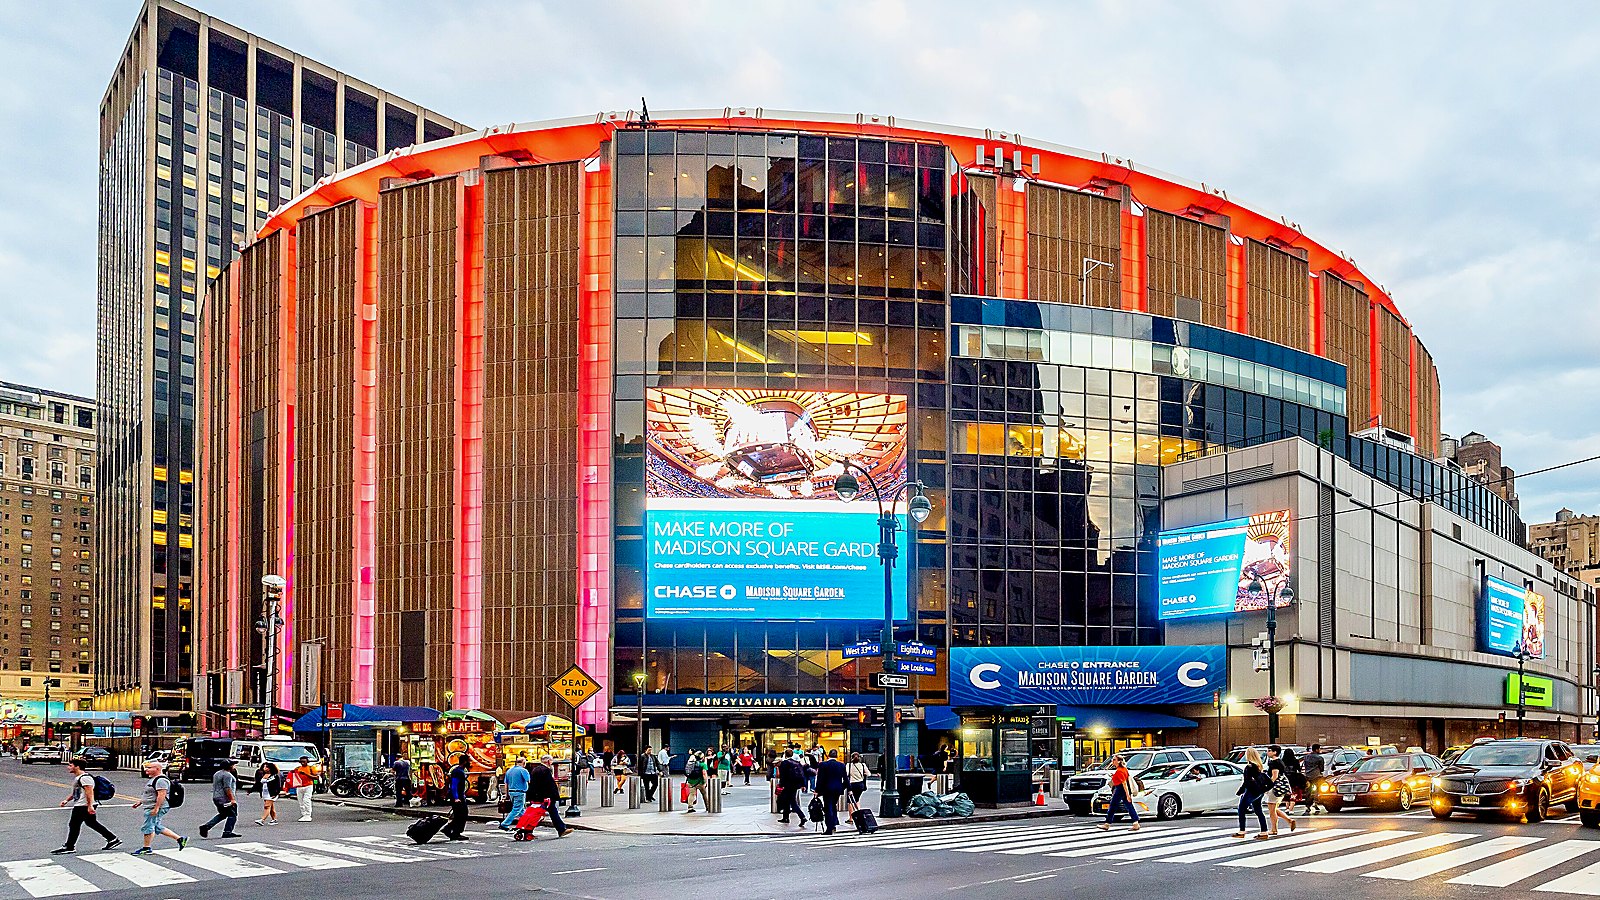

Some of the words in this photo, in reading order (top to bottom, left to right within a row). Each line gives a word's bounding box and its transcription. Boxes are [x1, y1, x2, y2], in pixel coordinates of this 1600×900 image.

[654, 521, 704, 537] MAKE
[709, 521, 764, 537] MORE
[768, 522, 794, 538] OF
[654, 540, 741, 556] MADISON
[745, 540, 819, 558] SQUARE
[823, 542, 880, 557] GARDE
[1162, 555, 1177, 563] MAKE
[1178, 553, 1195, 561] MORE
[1196, 551, 1205, 559] OF
[1162, 562, 1188, 570] MADISON
[1190, 558, 1212, 567] SQUARE
[1213, 554, 1238, 562] GARDEN
[654, 585, 718, 598] CHASE
[1162, 595, 1188, 606] CHASE
[845, 647, 860, 656] West
[860, 646, 871, 654] 33rd
[872, 645, 879, 653] St
[900, 645, 920, 656] Eighth
[921, 647, 934, 656] Ave
[900, 663, 910, 671] Joe
[910, 663, 924, 672] Louis
[969, 663, 1002, 689] C
[1018, 670, 1068, 686] MADISON
[1071, 670, 1112, 687] SQUARE
[1177, 661, 1209, 688] C
[561, 679, 588, 687] DEAD
[686, 697, 787, 706] PENNSYLVANIA
[792, 697, 845, 705] STATION
[446, 721, 483, 732] ALAFEL
